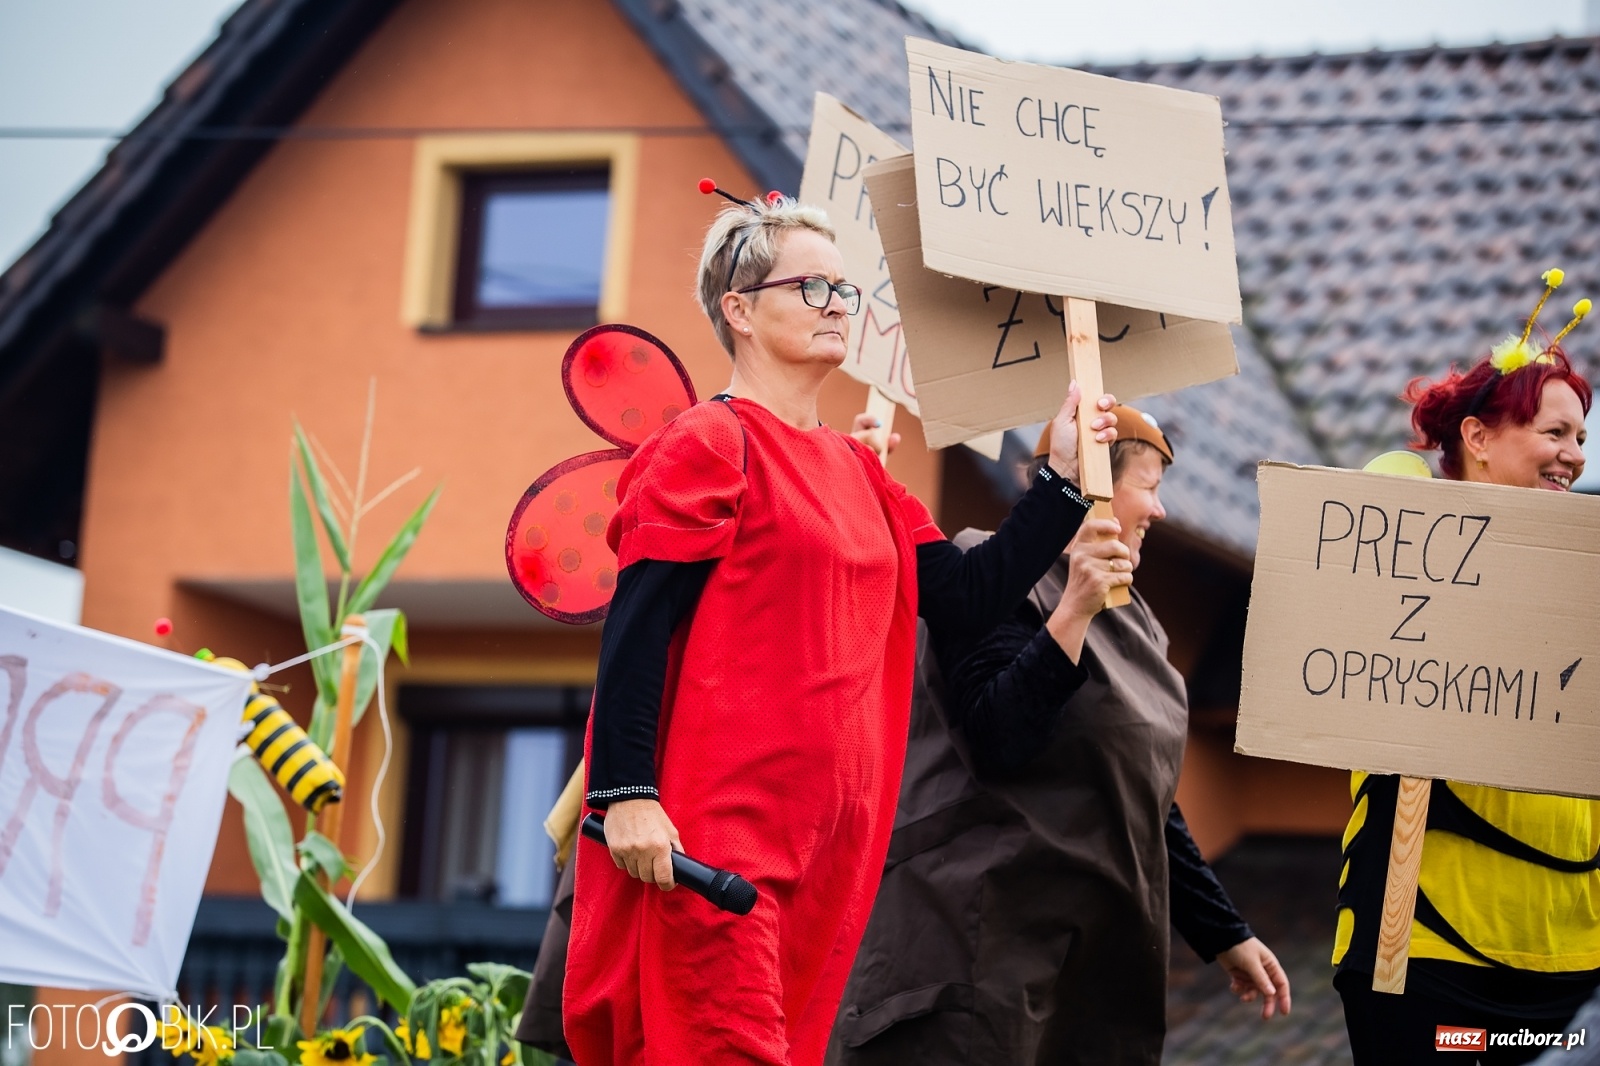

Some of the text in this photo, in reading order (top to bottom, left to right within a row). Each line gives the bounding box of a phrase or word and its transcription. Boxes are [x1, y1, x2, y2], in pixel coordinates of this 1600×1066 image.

[928, 65, 1106, 158] NIE CHCĘ
[936, 157, 1009, 216] BYĆ
[1316, 500, 1492, 586] PRECZ
[1390, 594, 1431, 642] Z
